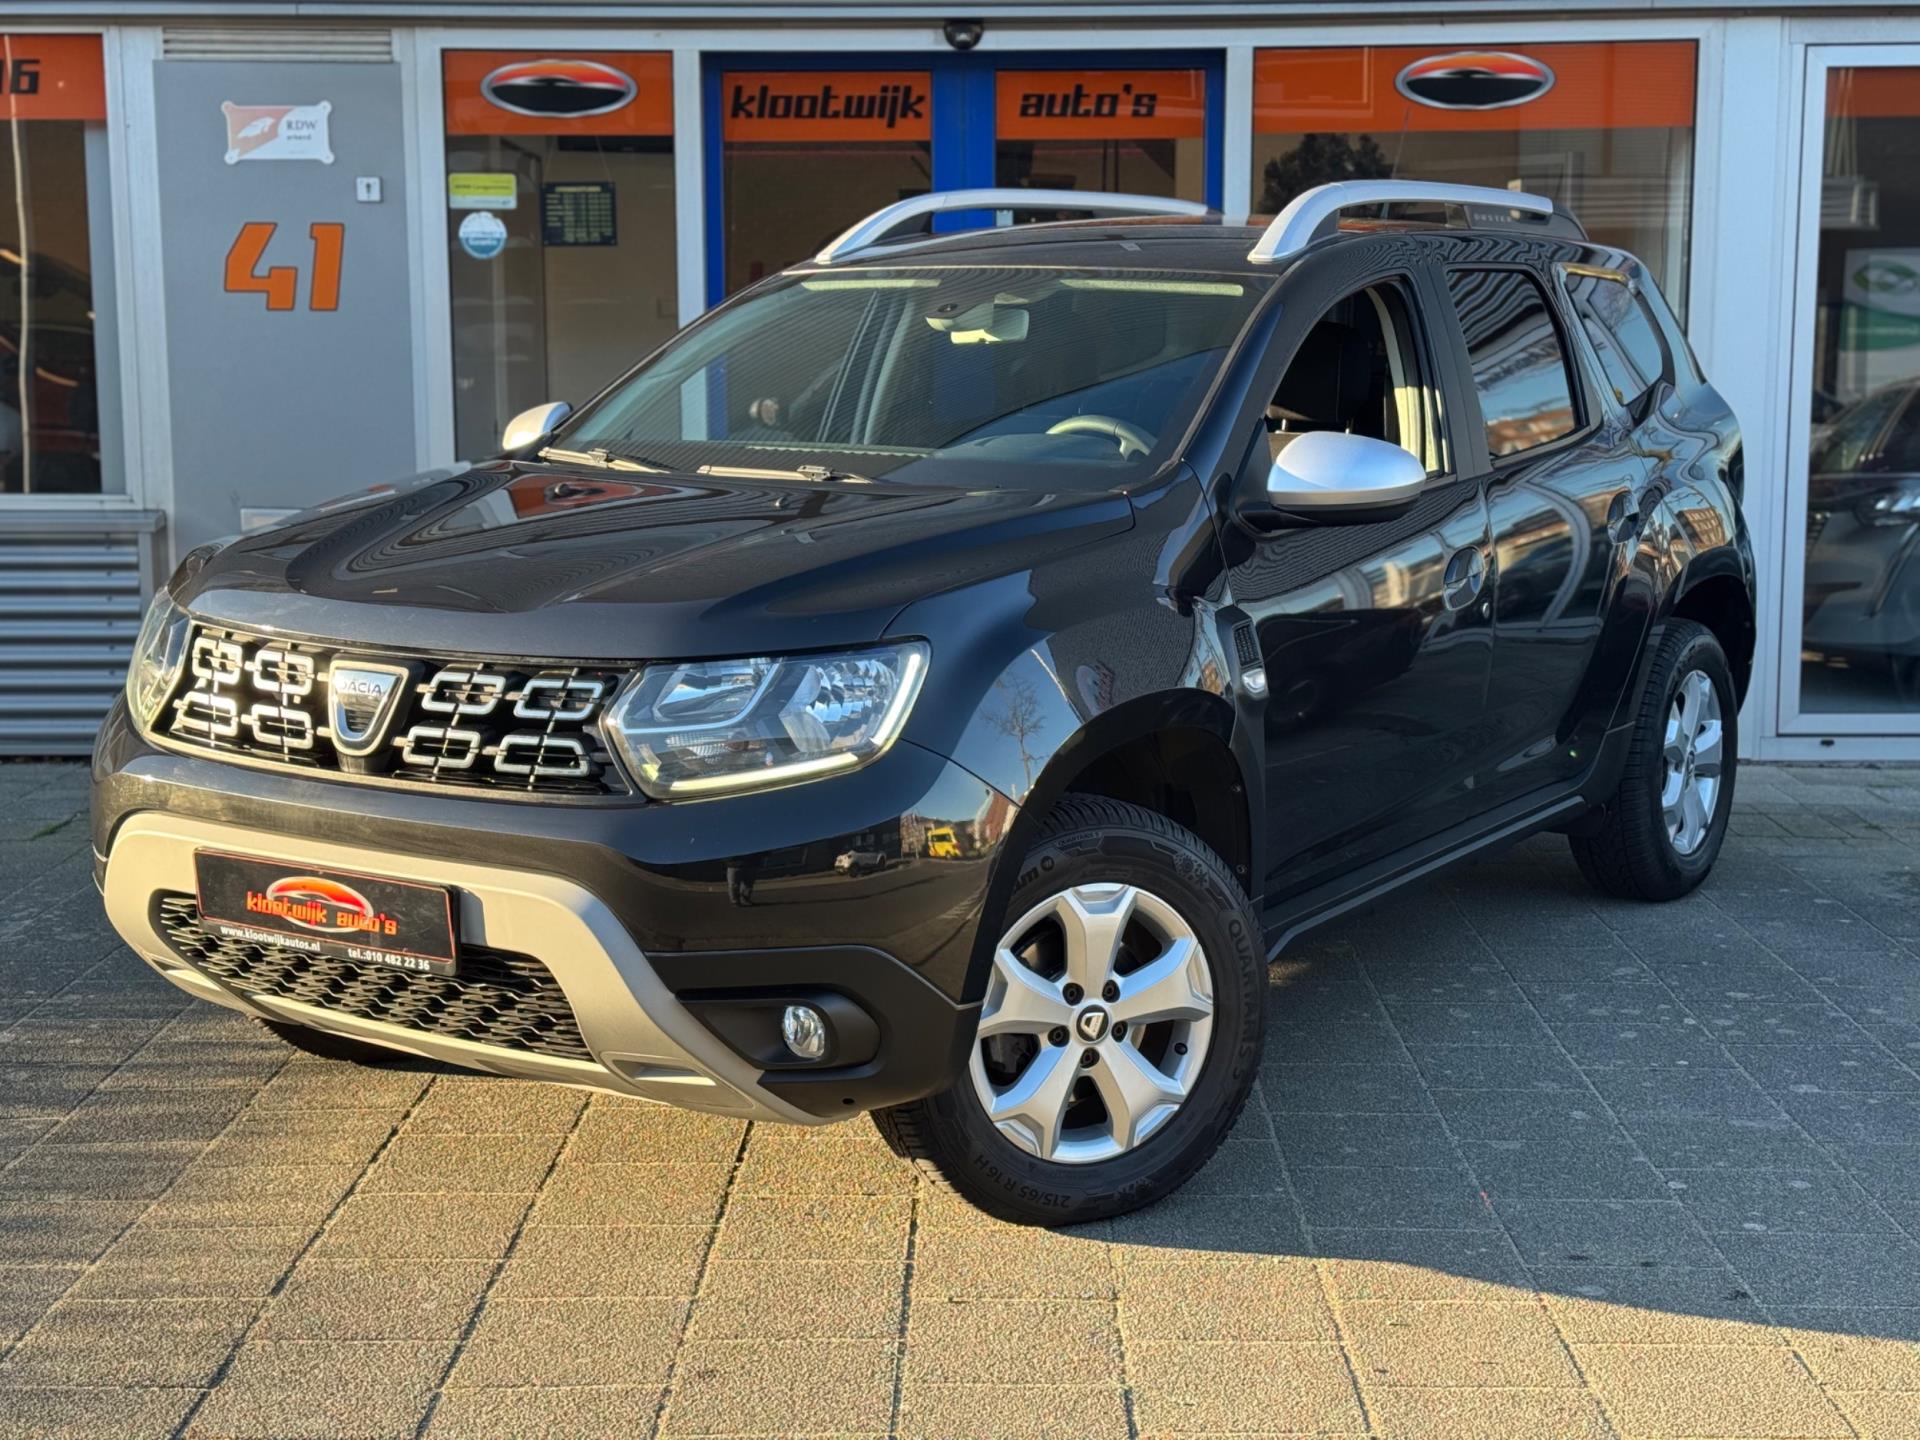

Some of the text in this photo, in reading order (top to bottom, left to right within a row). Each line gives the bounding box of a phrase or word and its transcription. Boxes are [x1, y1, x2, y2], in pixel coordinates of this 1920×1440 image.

[0, 59, 40, 95] 6
[731, 84, 1158, 129] klootwijk auto's
[223, 222, 345, 311] 41
[246, 891, 398, 935] klootwijk auto's
[220, 926, 321, 952] www.klootwijkautos.nl
[384, 953, 402, 966] 482
[403, 956, 417, 968] 22
[417, 959, 431, 970] 36
[986, 1166, 1002, 1184] 16
[1003, 1178, 1016, 1192] R
[1017, 1186, 1071, 1208] 215/65
